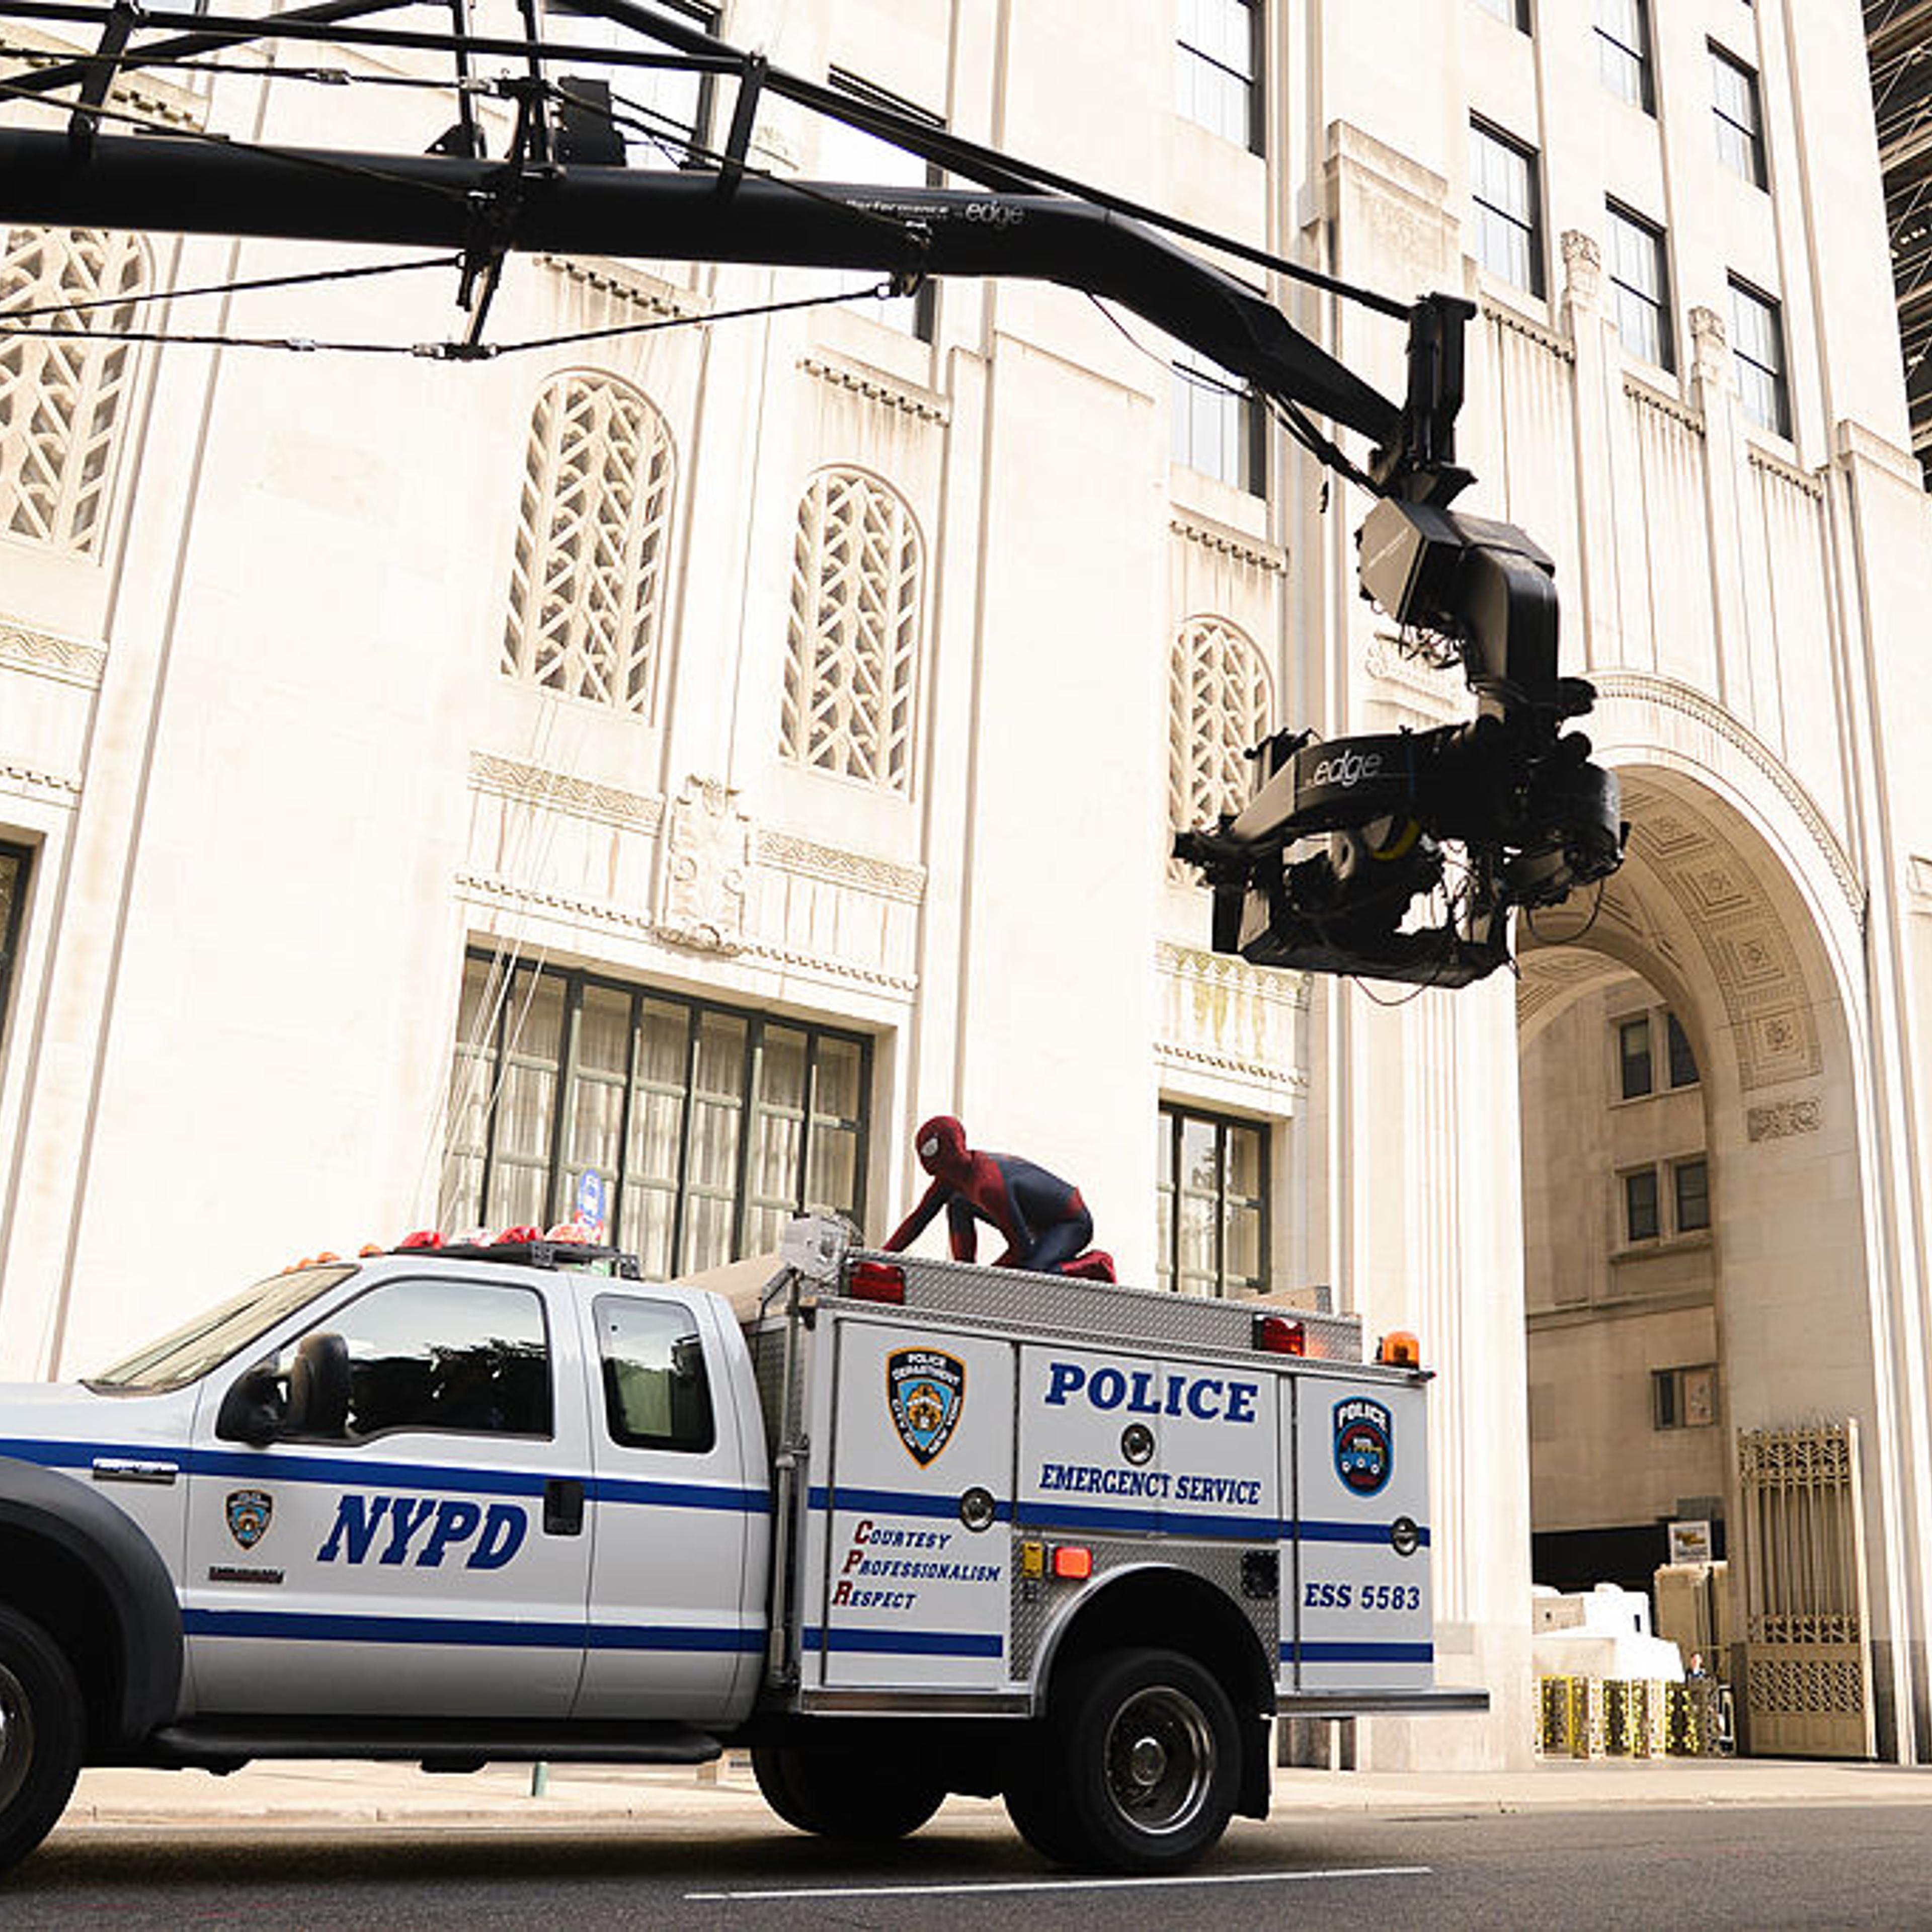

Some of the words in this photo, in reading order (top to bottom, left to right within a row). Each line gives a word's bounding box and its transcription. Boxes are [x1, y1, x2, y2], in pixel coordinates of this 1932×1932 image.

[965, 200, 1024, 229] edge
[1314, 749, 1382, 787] edge
[907, 1353, 947, 1369] POLICE
[1044, 1363, 1258, 1423] POLICE
[1338, 1402, 1388, 1432] POLICE
[1175, 1475, 1261, 1505] SERVICE
[316, 1495, 529, 1570] NYPD
[854, 1520, 952, 1549] COURTESY
[840, 1550, 1002, 1581] PROFESSIONALISM
[832, 1580, 917, 1609] RESPECT
[1304, 1583, 1352, 1608] ESS
[1360, 1585, 1420, 1610] 5583
